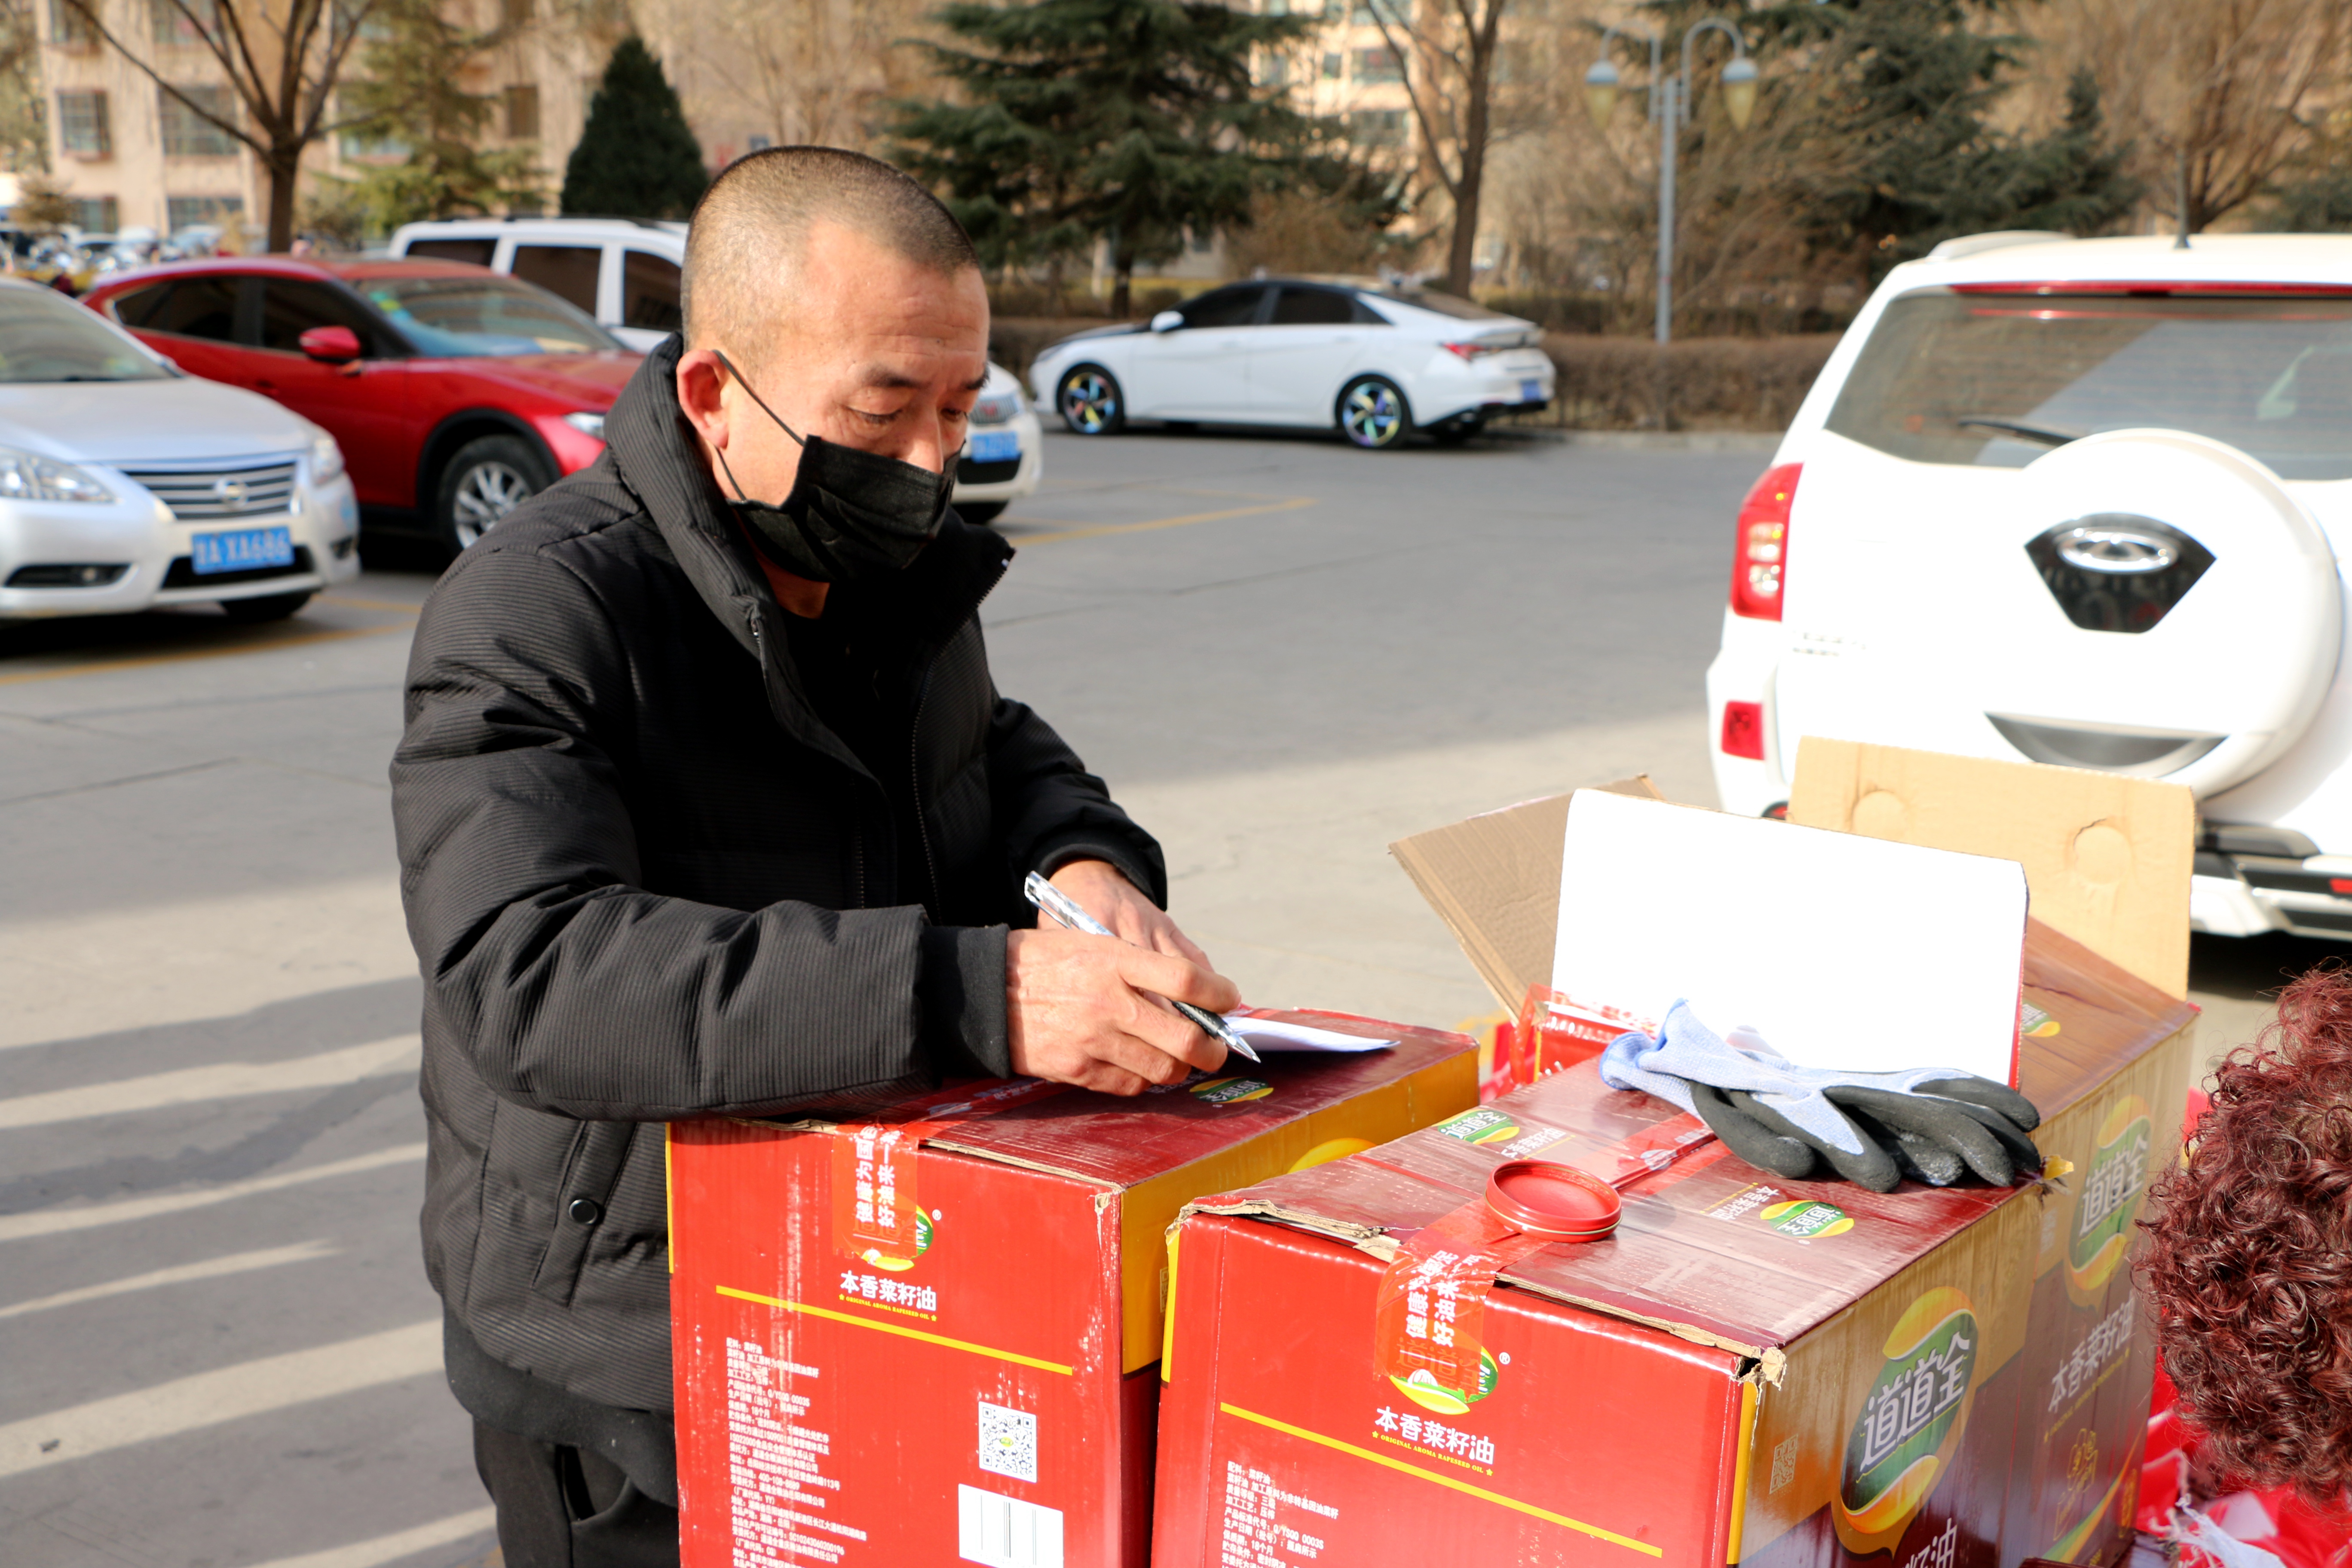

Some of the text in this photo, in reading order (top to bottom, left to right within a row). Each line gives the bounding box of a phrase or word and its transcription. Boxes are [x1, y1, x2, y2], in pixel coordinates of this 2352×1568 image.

[1441, 1111, 1507, 1139] 道道全
[1709, 1186, 1779, 1220] 本香菜籽油
[2080, 1134, 2147, 1236] 道道全
[1776, 1205, 1841, 1235] 道道全
[839, 1270, 937, 1311] 本香菜籽油
[846, 1296, 871, 1307] ORIGINAL
[872, 1302, 891, 1311] AROMA
[892, 1306, 918, 1318] RAPESEED
[2049, 1289, 2135, 1414] 本香菜籽油
[1860, 1332, 1969, 1472] 道道全
[1375, 1406, 1495, 1464] 本香菜籽油
[1381, 1434, 1484, 1473] ORIGINAL AROMA RAPESEED OIL
[1225, 1494, 1275, 1520] 加工工艺：压榨
[1227, 1472, 1339, 1519] 菜籽油 加工原料为非转基因油菜籽
[1223, 1529, 1273, 1556] 保质期：18个月
[1302, 1534, 1324, 1550] 0003S
